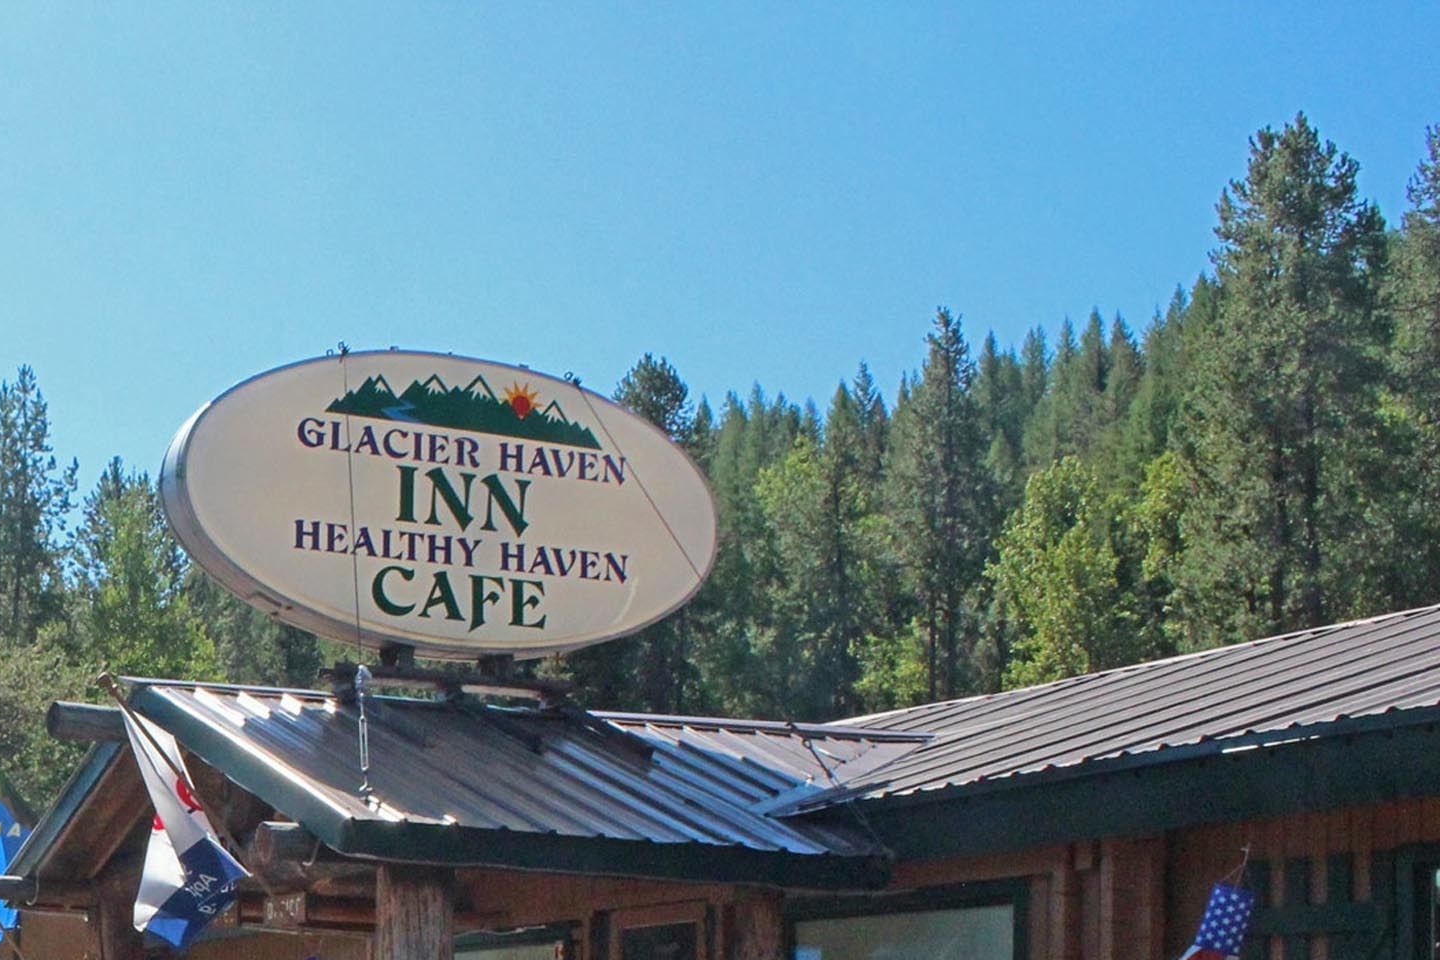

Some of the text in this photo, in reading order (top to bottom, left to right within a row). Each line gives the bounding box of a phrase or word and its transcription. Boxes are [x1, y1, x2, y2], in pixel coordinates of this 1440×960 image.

[297, 417, 627, 486] GLACIER HAVEN
[395, 464, 531, 537] INN
[294, 519, 629, 584] HEALTHY HAVEN
[371, 565, 547, 632] CAFE
